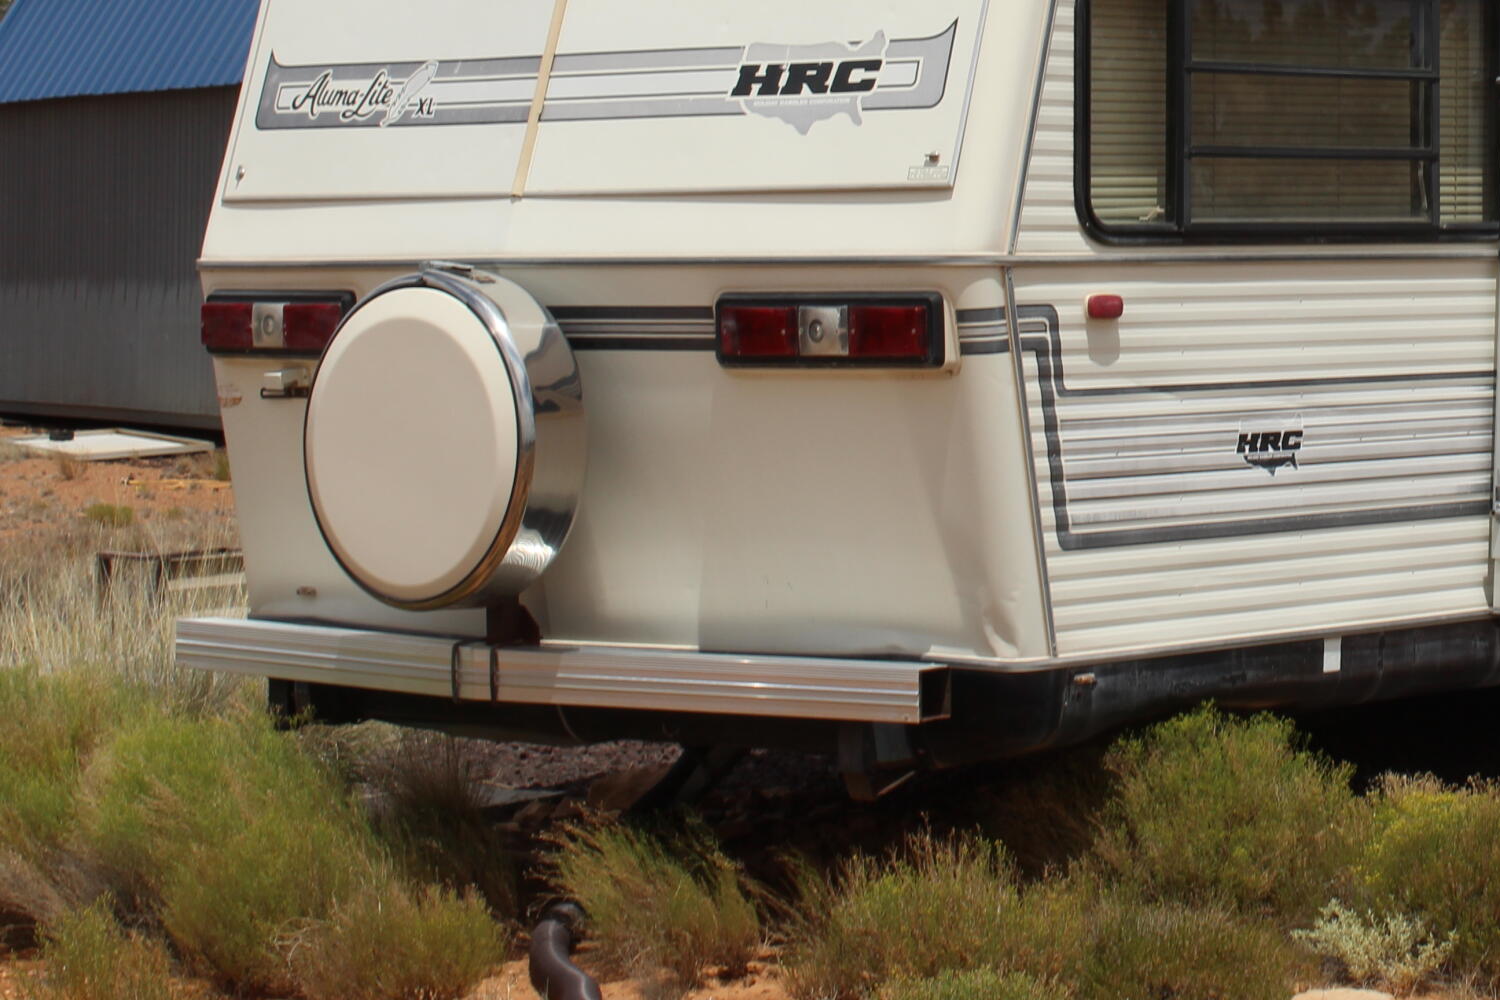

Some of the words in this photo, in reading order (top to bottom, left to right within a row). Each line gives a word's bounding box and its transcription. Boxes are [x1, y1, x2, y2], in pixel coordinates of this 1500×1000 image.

[292, 70, 394, 119] Aluma-Lite
[415, 97, 434, 116] XL
[731, 59, 883, 96] HRC
[1236, 430, 1304, 454] HRC
